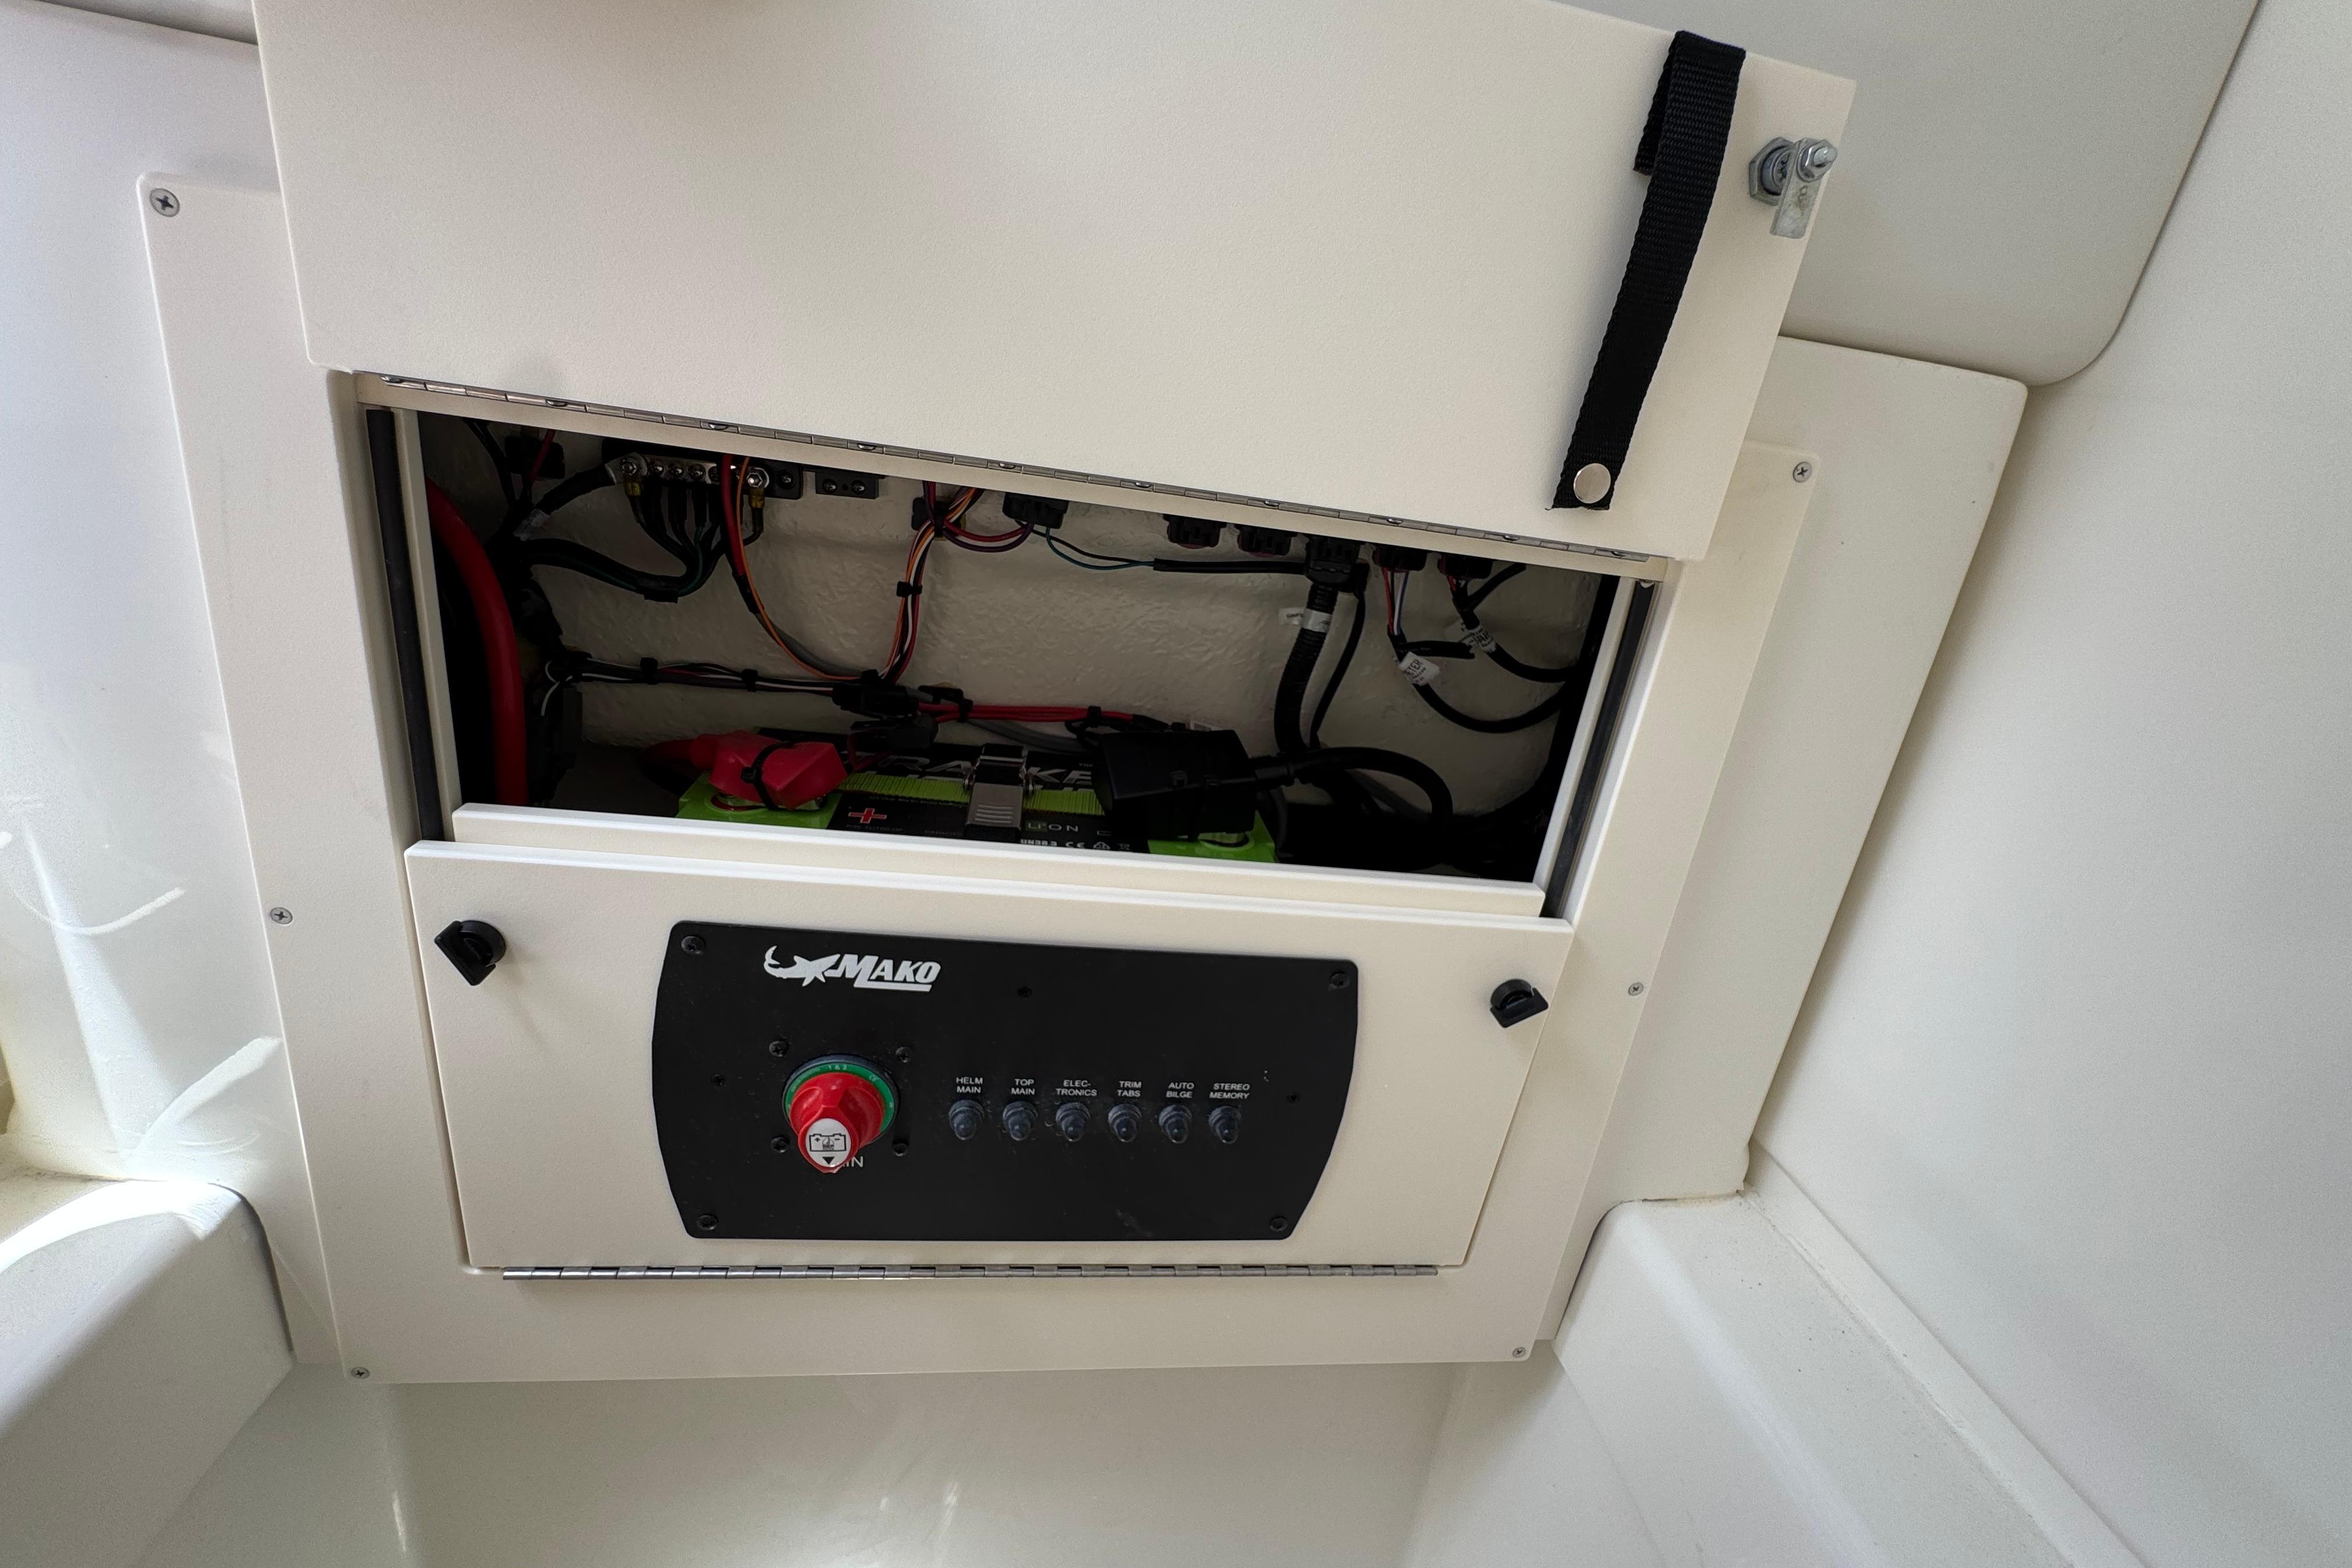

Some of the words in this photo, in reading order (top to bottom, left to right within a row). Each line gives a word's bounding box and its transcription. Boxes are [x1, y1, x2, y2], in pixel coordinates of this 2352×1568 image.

[824, 954, 942, 992] MAKO
[956, 1076, 984, 1084] HELM
[1063, 1079, 1091, 1087] ELEC-
[1119, 1080, 1142, 1088] TRIM
[1213, 1083, 1250, 1091] STEREO
[1055, 1088, 1097, 1097] TRONICS
[1166, 1090, 1193, 1098] BILGE
